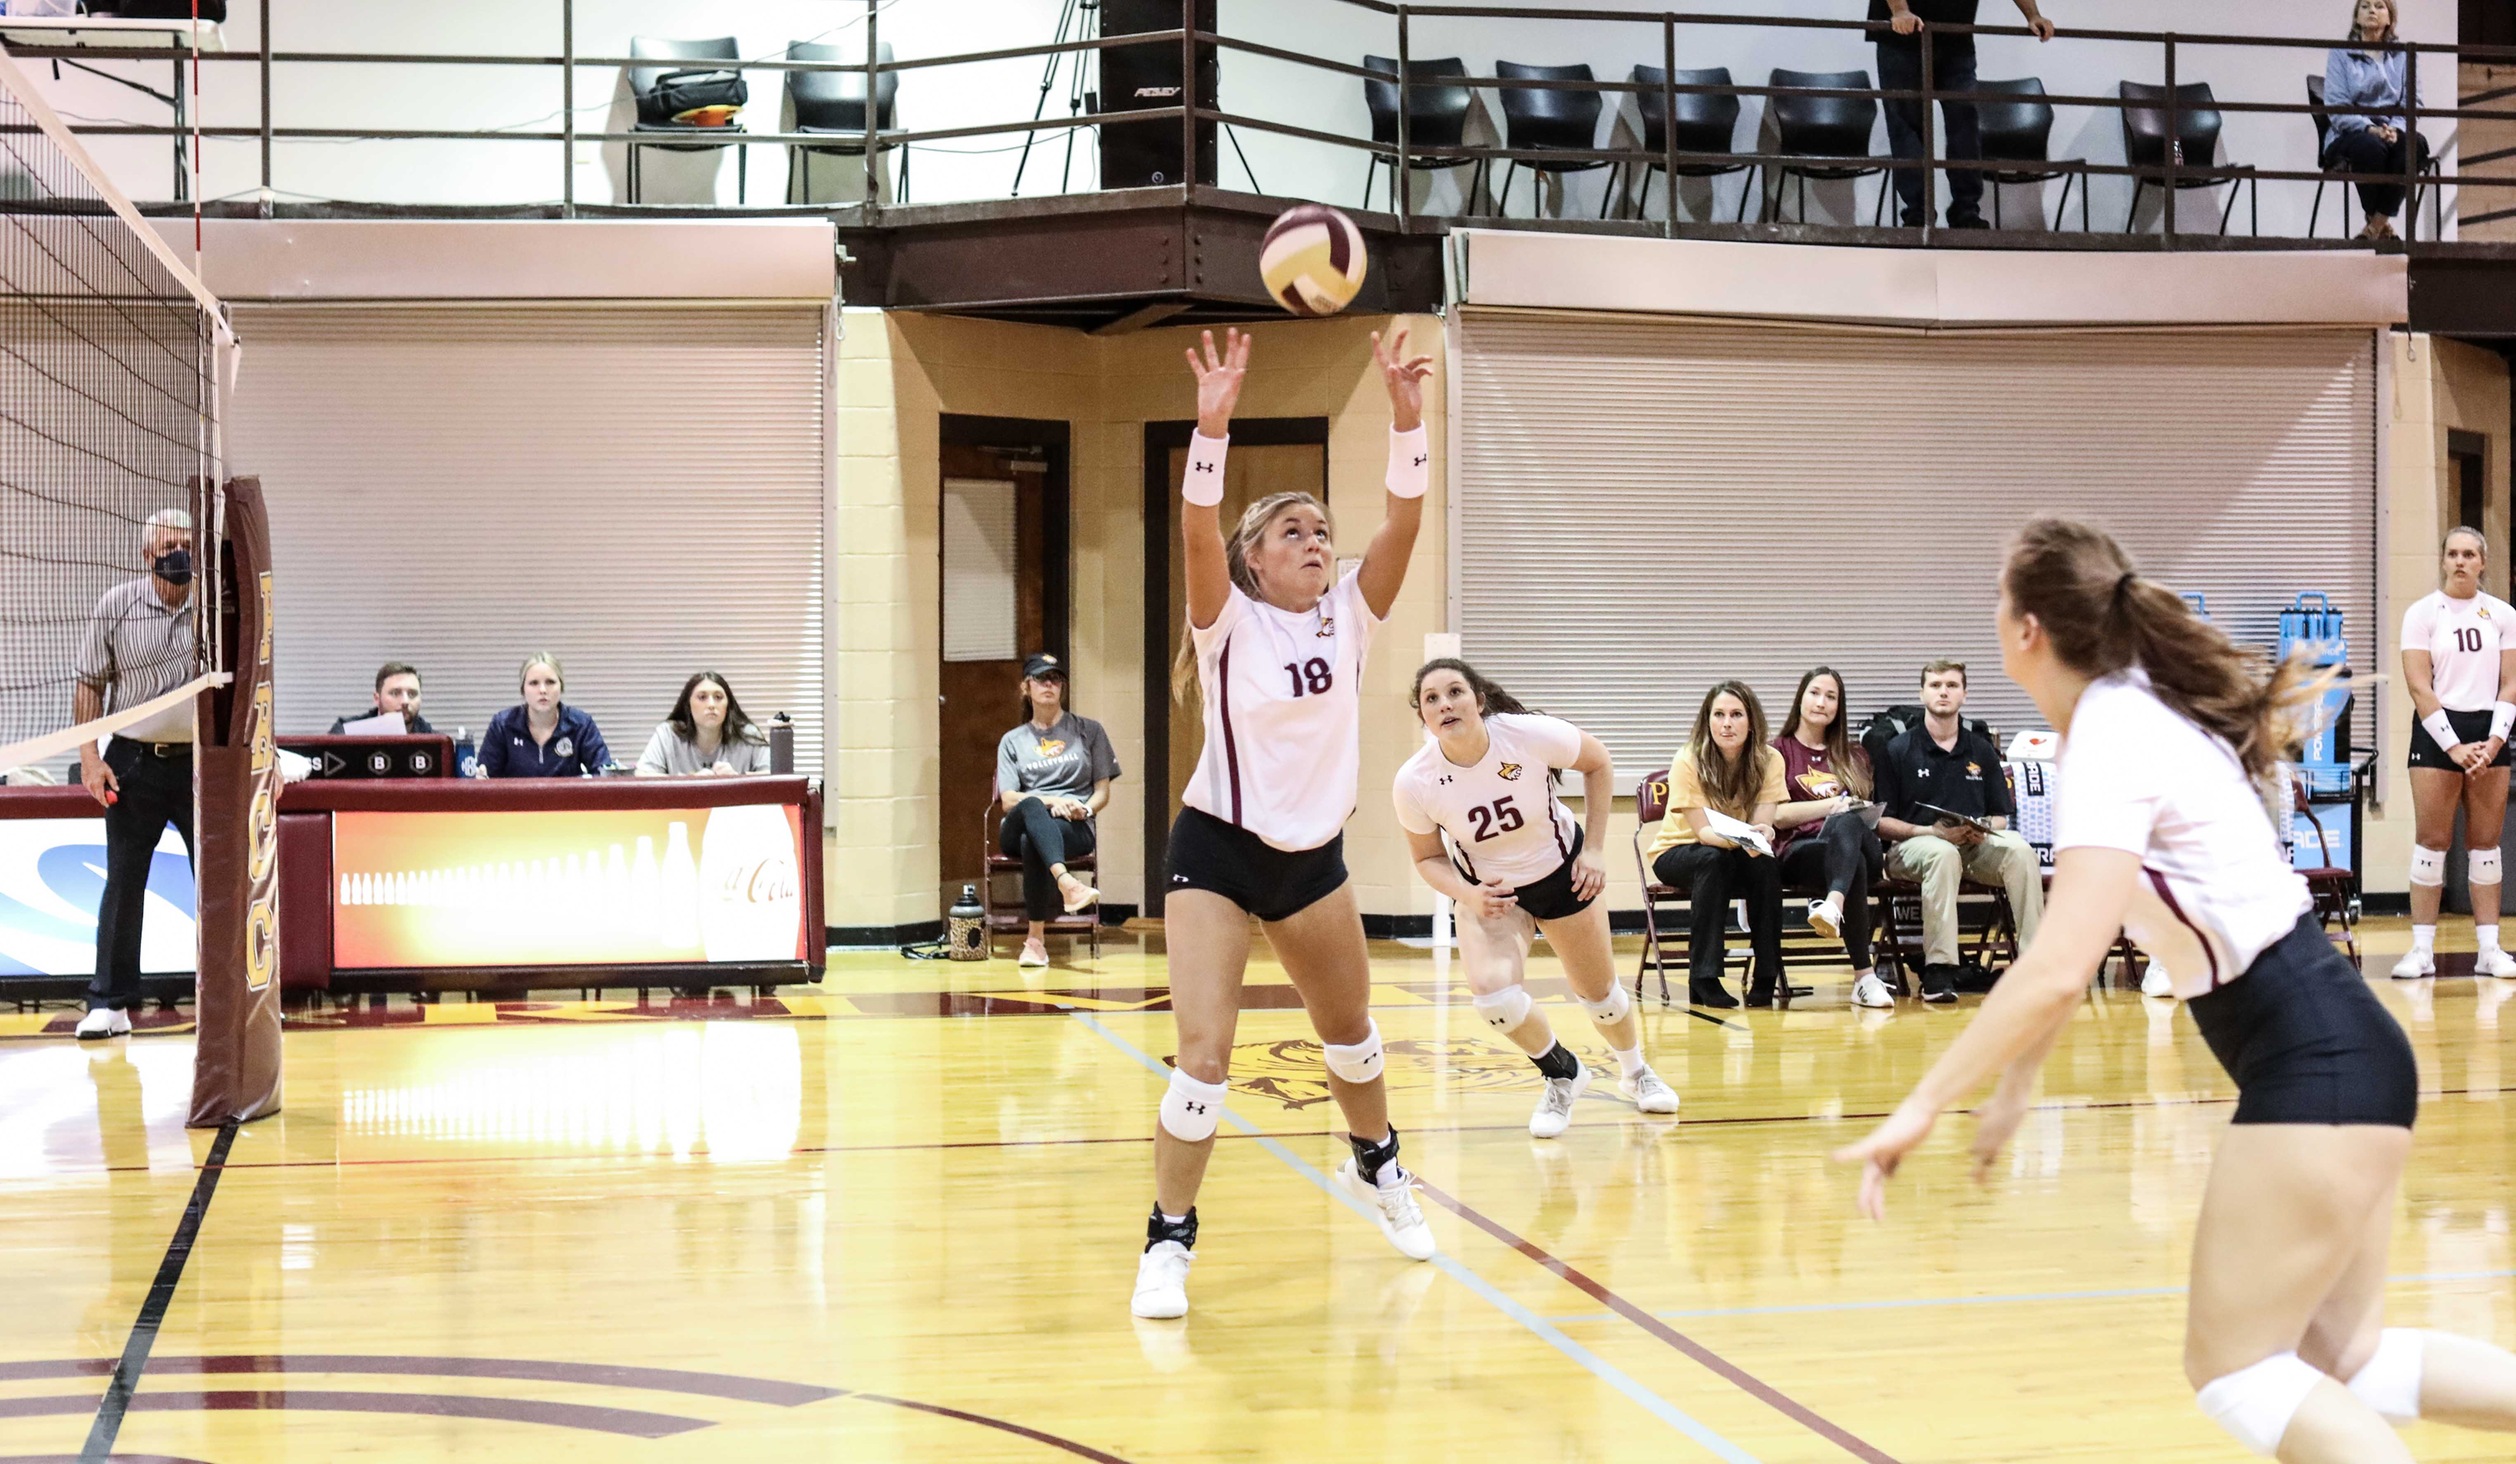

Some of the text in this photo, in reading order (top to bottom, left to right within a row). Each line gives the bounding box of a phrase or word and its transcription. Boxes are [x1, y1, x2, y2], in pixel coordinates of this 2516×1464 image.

[2453, 628, 2482, 652] 10
[1284, 657, 1332, 697] 18
[374, 757, 385, 769] B
[415, 756, 426, 769] B
[1026, 753, 1079, 771] VOLLEYBALL
[1468, 795, 1524, 843] 25
